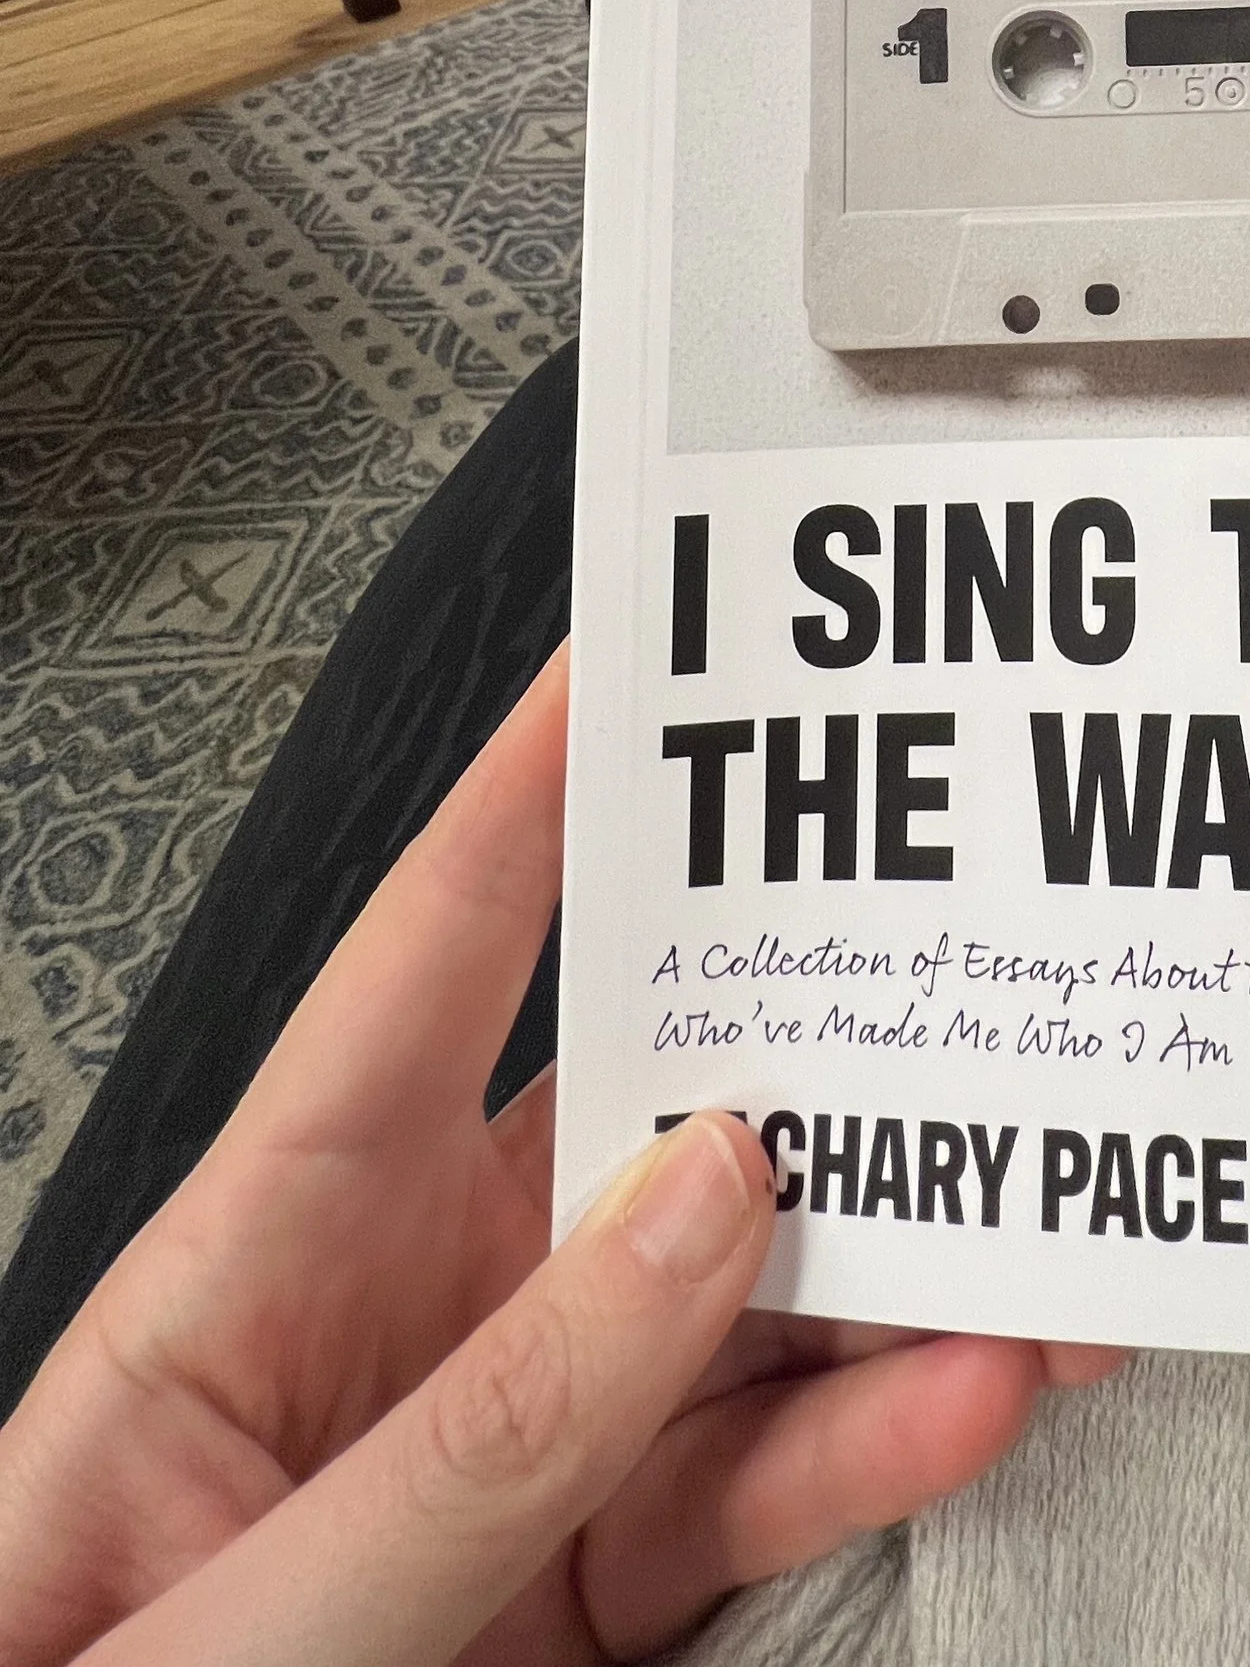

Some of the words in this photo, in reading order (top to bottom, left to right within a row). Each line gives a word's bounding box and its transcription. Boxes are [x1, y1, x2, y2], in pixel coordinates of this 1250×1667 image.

[882, 41, 920, 58] SIDE
[897, 7, 948, 84] 1
[671, 514, 709, 676] I
[792, 497, 1136, 669] SING
[662, 712, 955, 888] THE
[652, 945, 680, 984] A
[701, 933, 896, 979] Collection
[911, 932, 950, 997] of
[963, 942, 1098, 1005] Essays
[1111, 941, 1246, 992] About
[817, 1005, 928, 1048] Made
[943, 1010, 1000, 1051] Me
[1017, 1015, 1102, 1058] Who
[1122, 1021, 1145, 1063] I
[1159, 1014, 1233, 1072] Am
[654, 1109, 1019, 1229] CHARY
[1041, 1128, 1248, 1245] PACE
